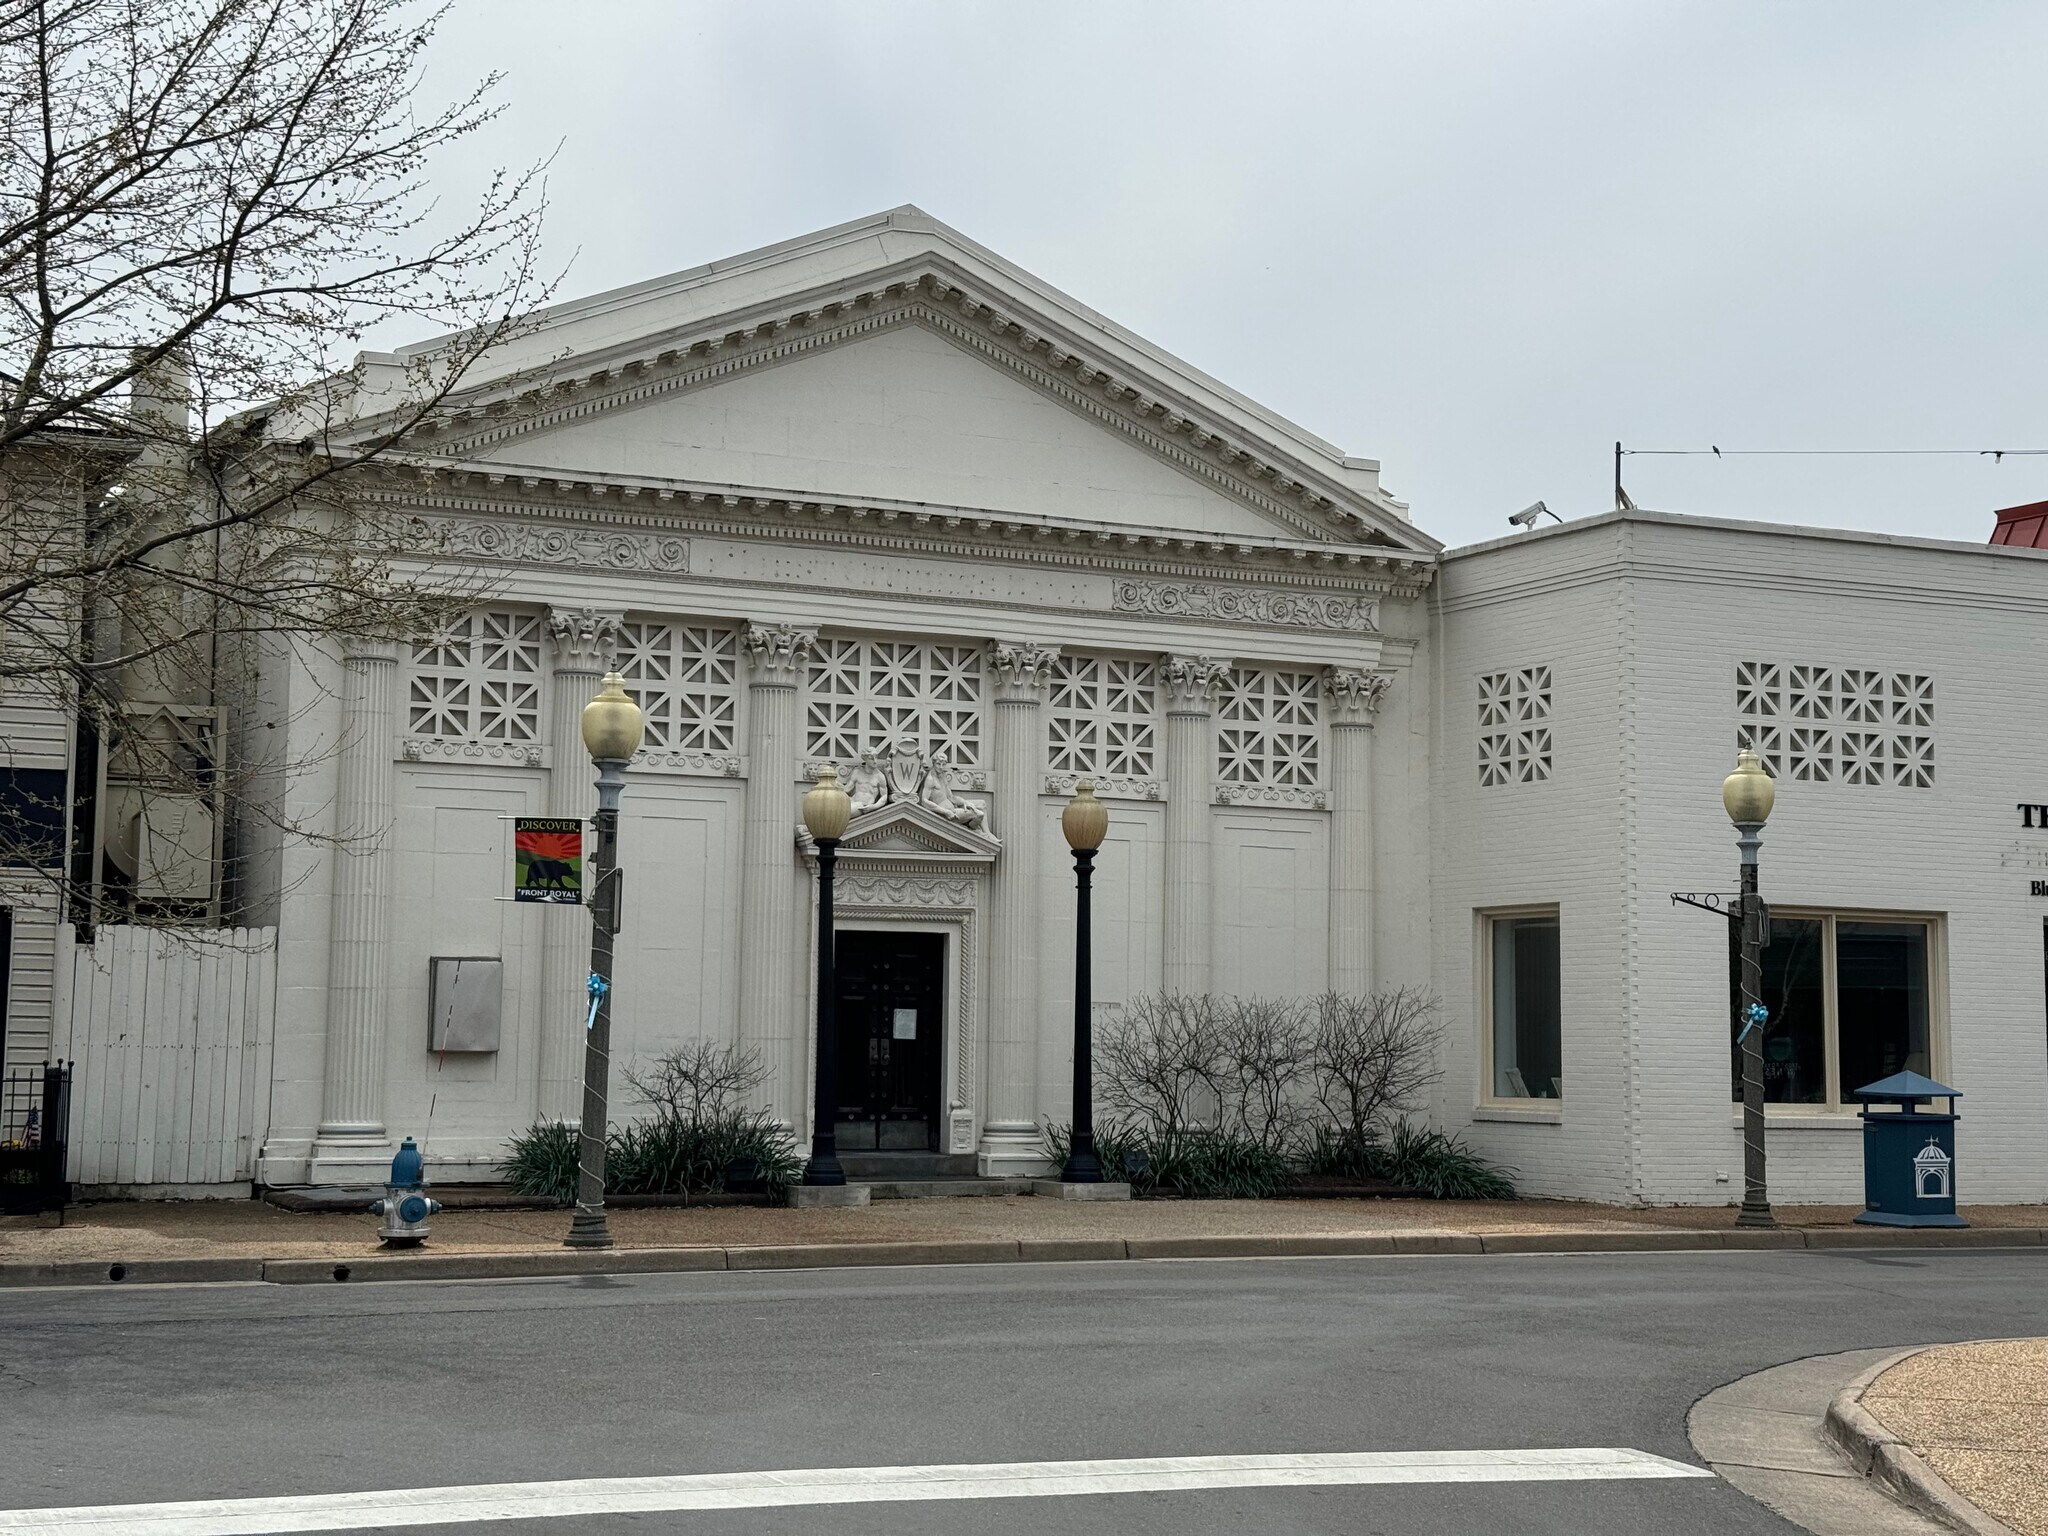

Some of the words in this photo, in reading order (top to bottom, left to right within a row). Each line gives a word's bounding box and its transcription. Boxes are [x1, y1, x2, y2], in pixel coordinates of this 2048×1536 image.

[899, 762, 915, 780] W
[520, 820, 576, 831] DISCOVER
[550, 890, 576, 898] ROYAL
[2030, 880, 2048, 896] Bl
